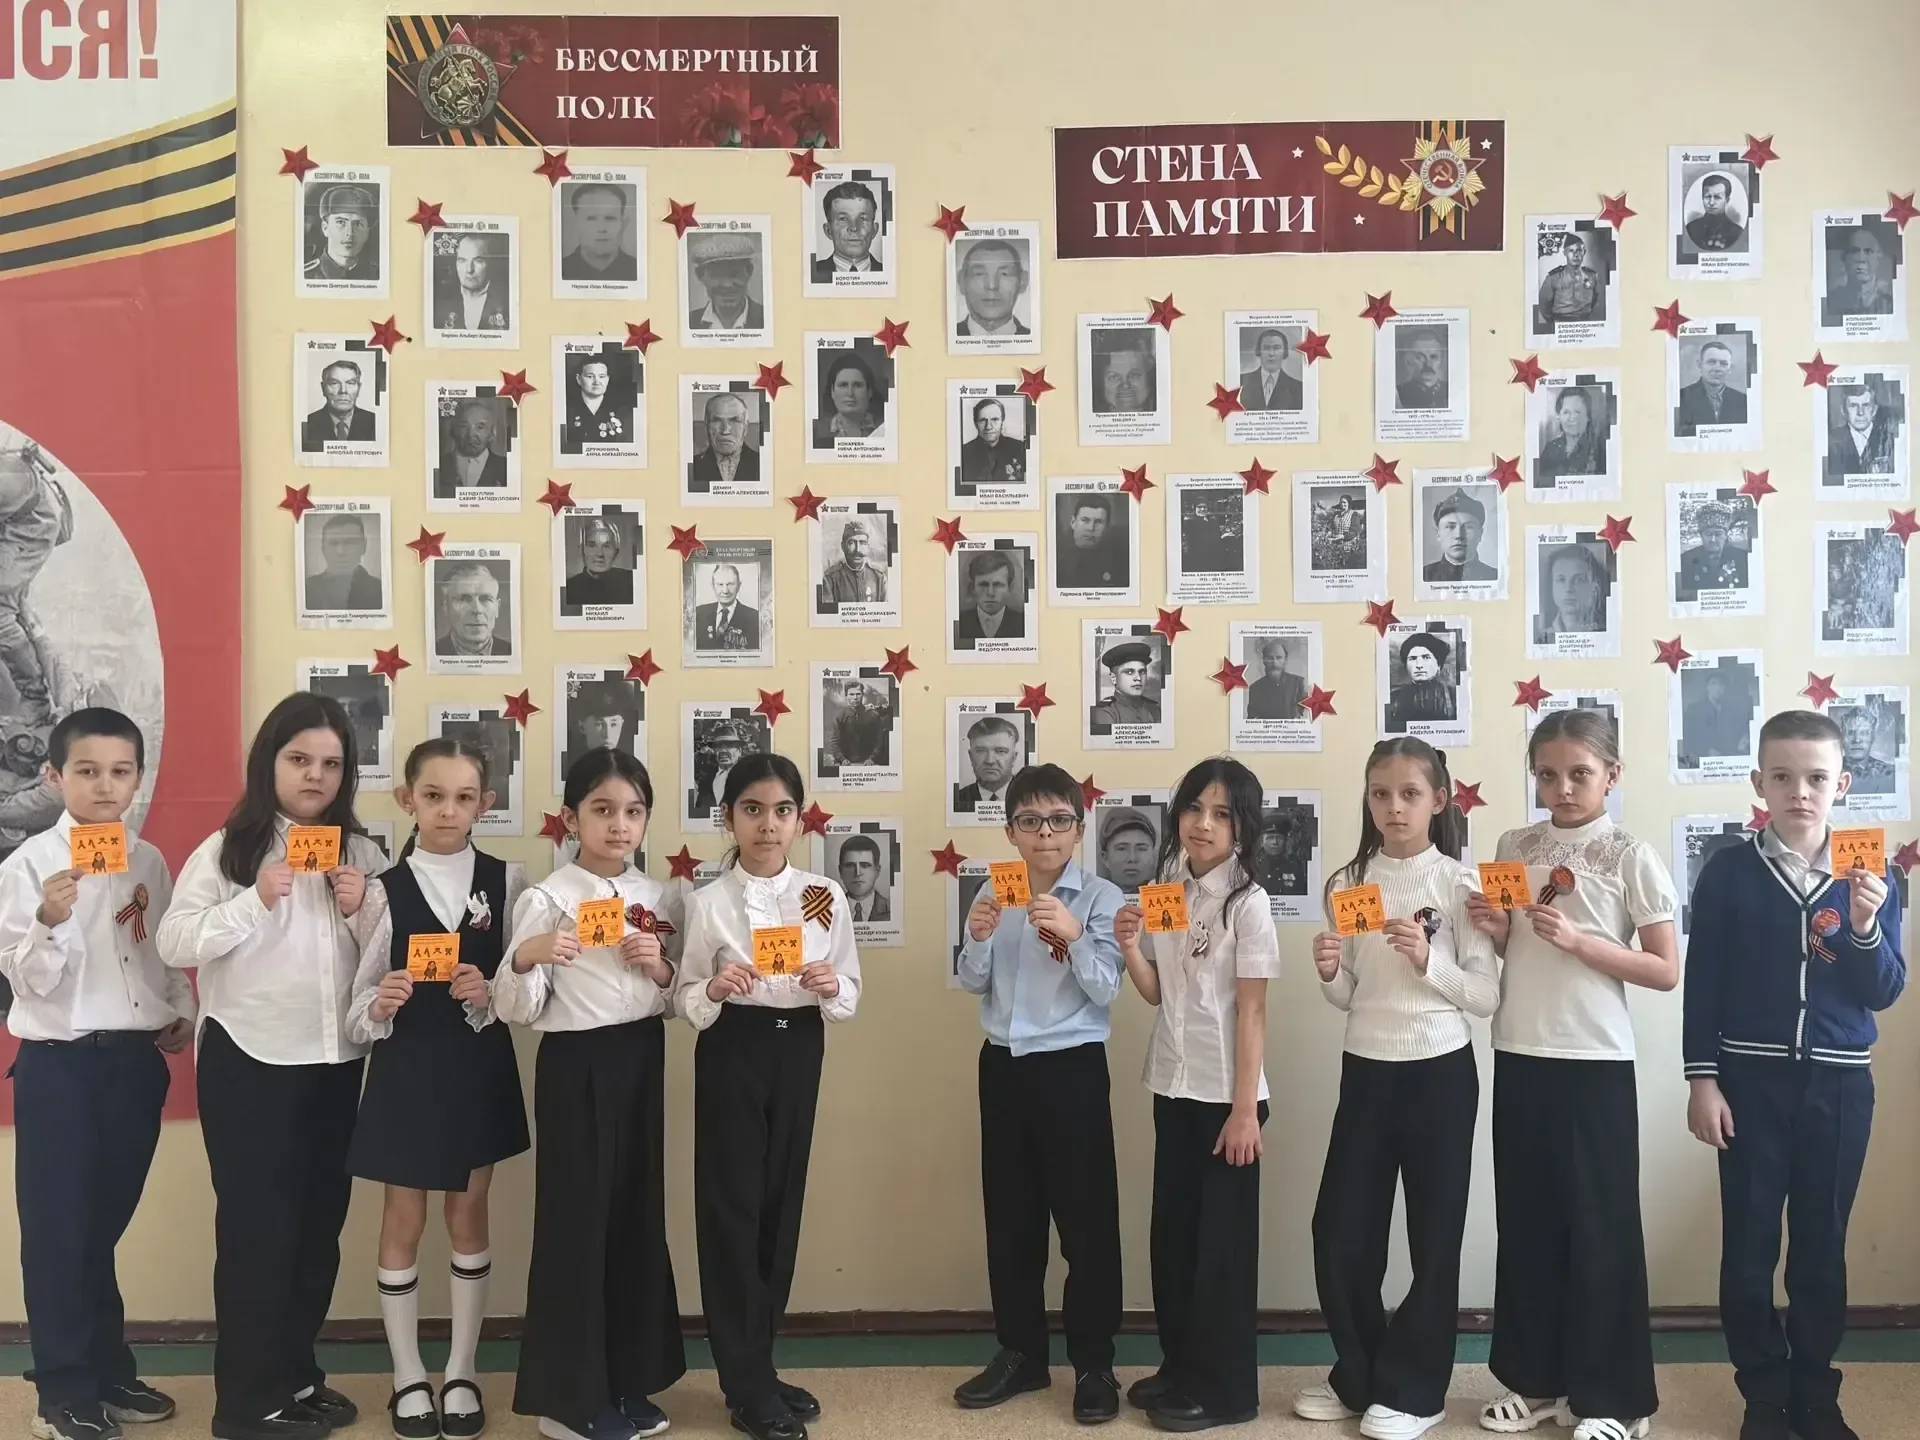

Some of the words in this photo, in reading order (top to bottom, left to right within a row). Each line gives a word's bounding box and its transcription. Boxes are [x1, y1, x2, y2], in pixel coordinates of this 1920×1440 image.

[0, 0, 158, 80] СЯ!
[555, 44, 819, 74] БЕССМЕРТНЫЙ
[556, 95, 656, 120] ПОЛК
[1092, 143, 1262, 185] СТЕНА
[1092, 195, 1317, 239] ПАМЯТИ
